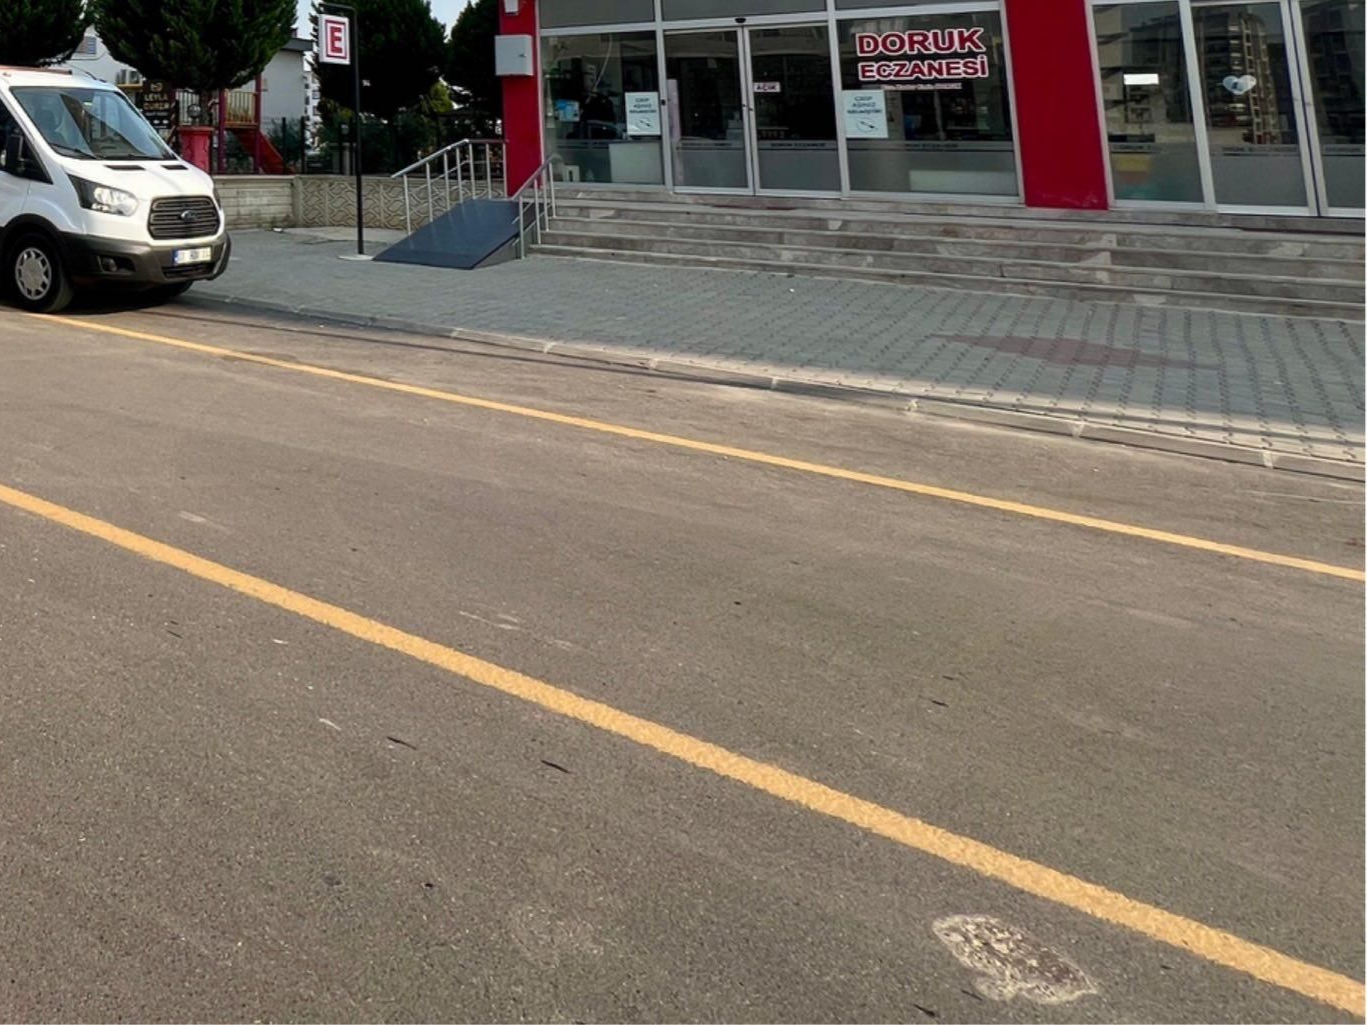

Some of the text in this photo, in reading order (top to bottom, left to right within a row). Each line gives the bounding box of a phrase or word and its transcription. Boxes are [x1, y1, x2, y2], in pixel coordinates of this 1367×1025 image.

[329, 26, 343, 53] E
[857, 28, 985, 56] DORUK
[859, 56, 989, 80] ECZANESİ
